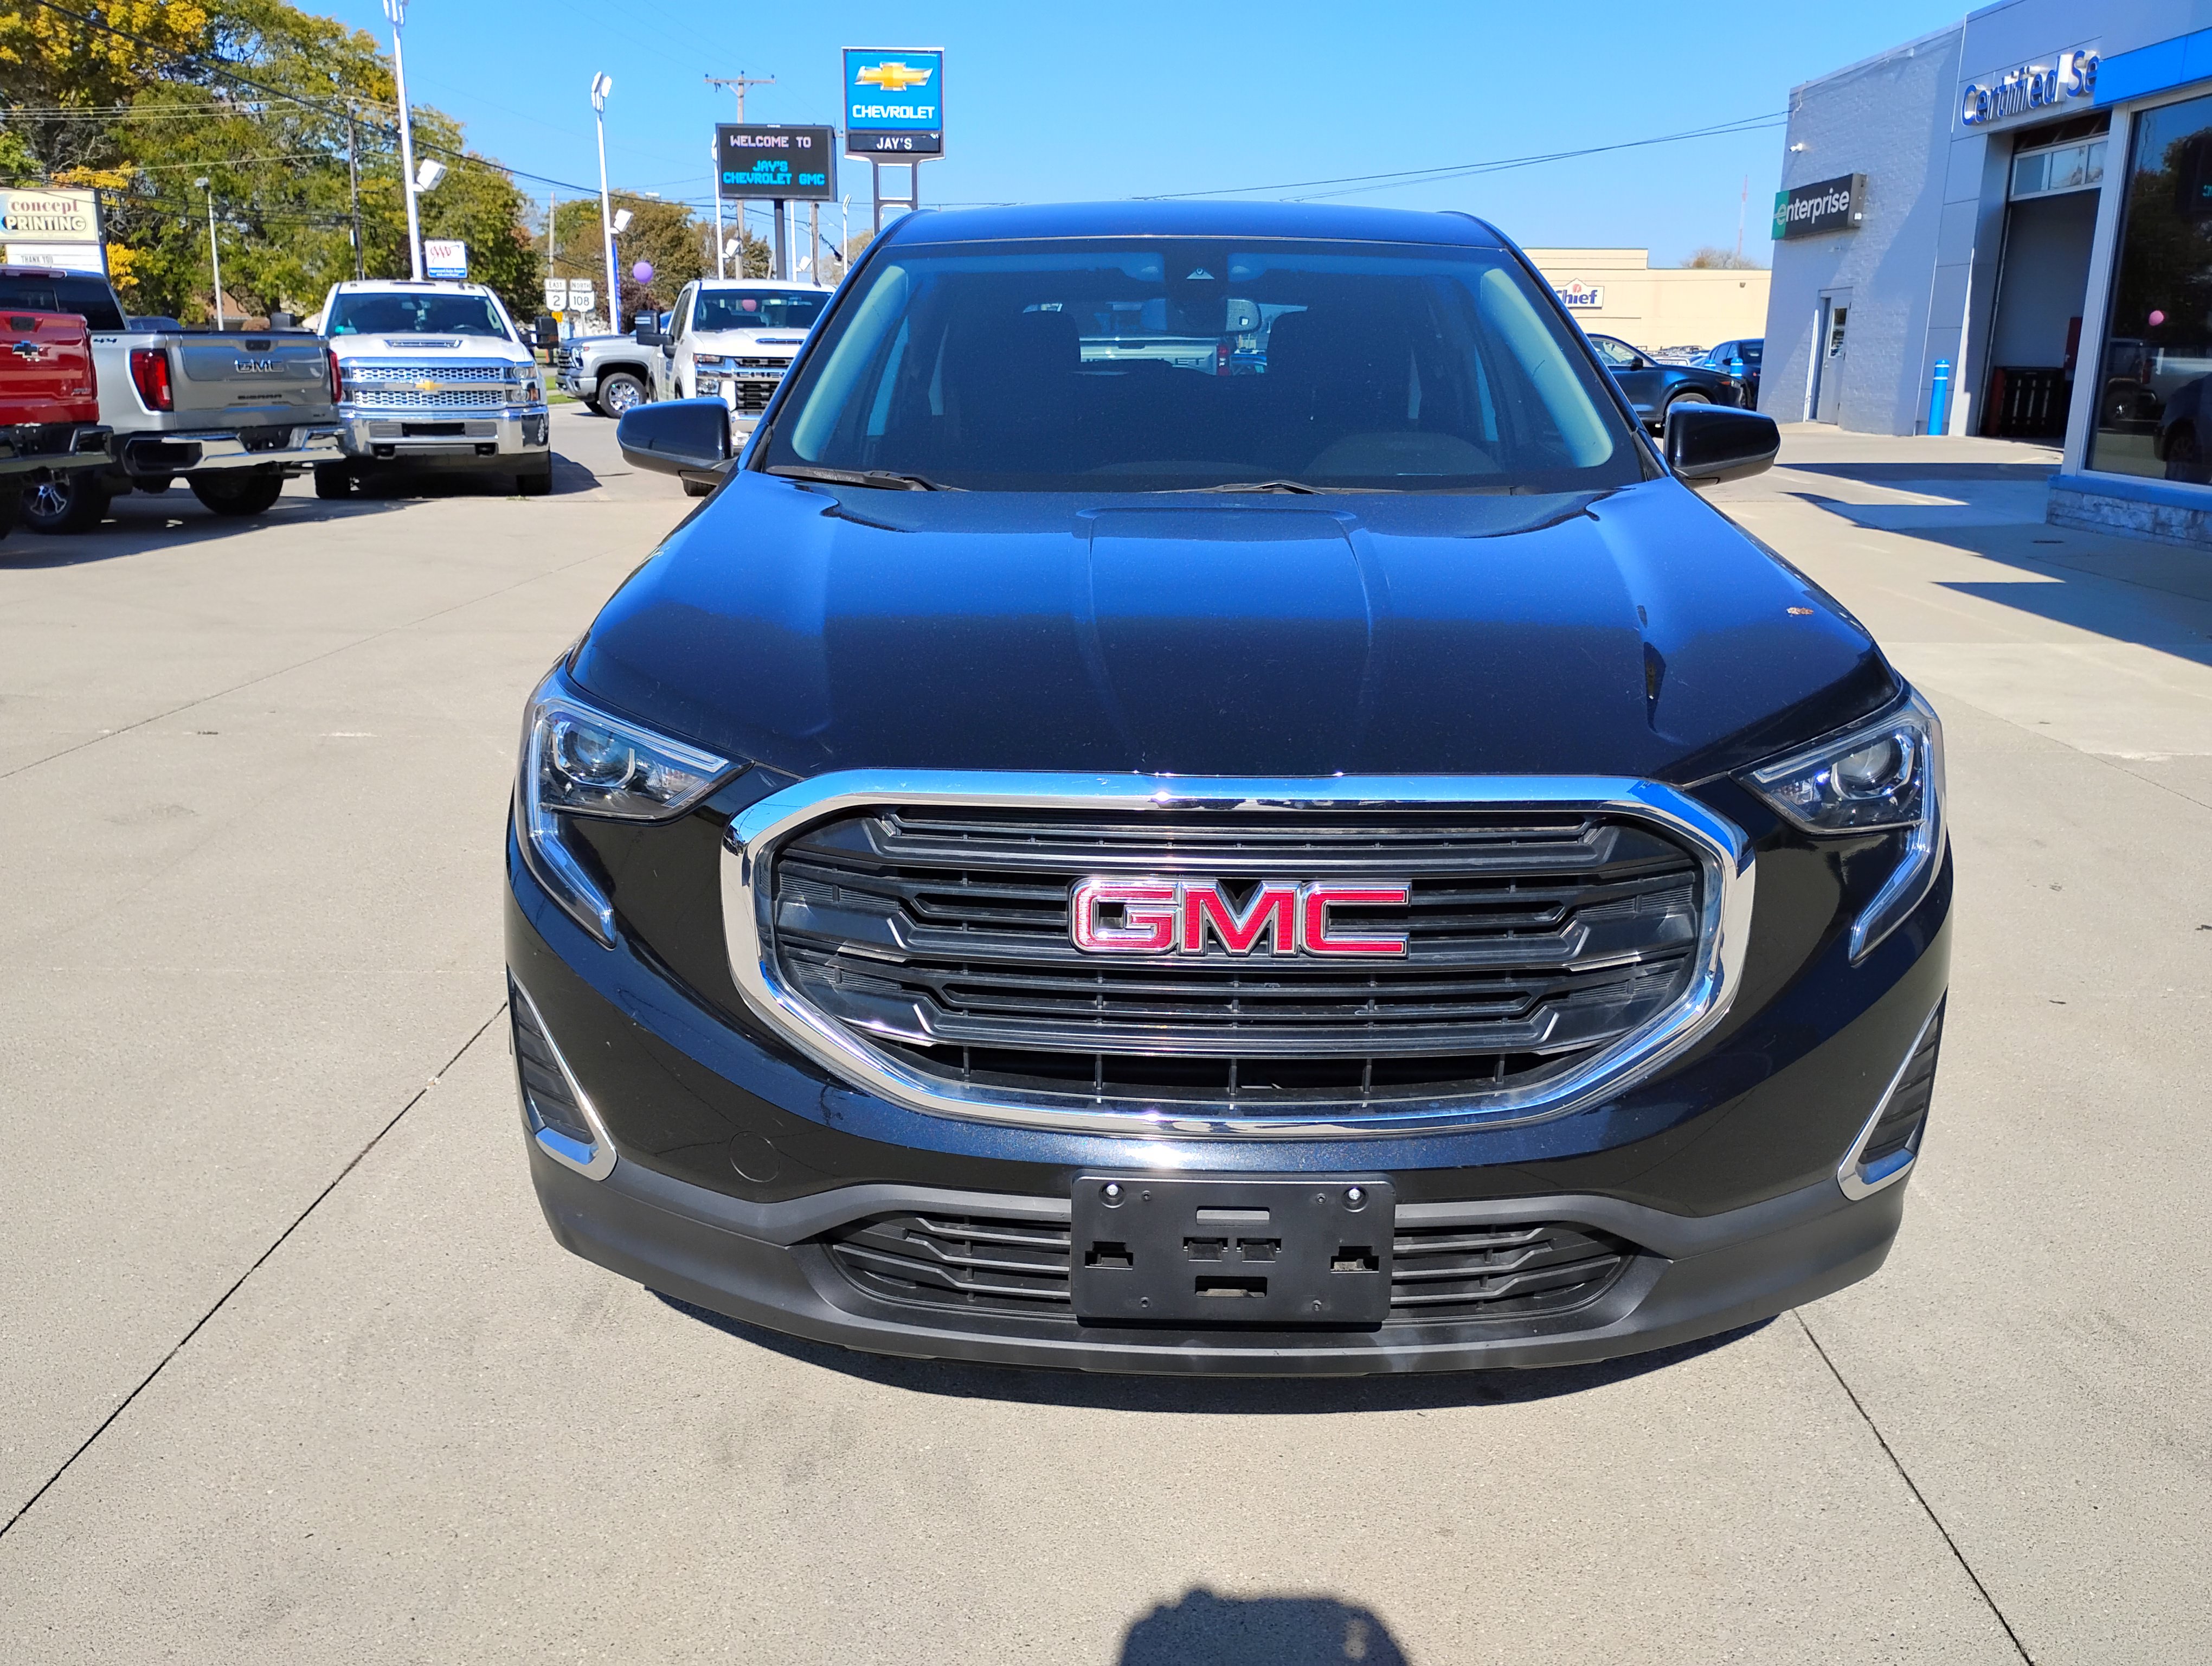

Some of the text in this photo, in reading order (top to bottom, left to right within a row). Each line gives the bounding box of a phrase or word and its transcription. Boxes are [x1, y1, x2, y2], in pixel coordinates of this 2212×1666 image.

[1961, 54, 2061, 126] Certified
[852, 105, 935, 119] CHEVROLET
[730, 135, 811, 148] WELCOME TO
[876, 137, 912, 150] JAY'S
[753, 161, 788, 172] JAY'S
[723, 172, 825, 185] CHEVROLET GMC
[11, 199, 80, 214] concept
[1773, 188, 1849, 225] enterprise
[6, 216, 87, 230] PRINTING
[21, 255, 54, 264] THANK YOU
[553, 295, 589, 306] 2 108
[1555, 289, 1598, 304] hief
[234, 358, 284, 373] GMC
[1071, 876, 1411, 959] GMC
